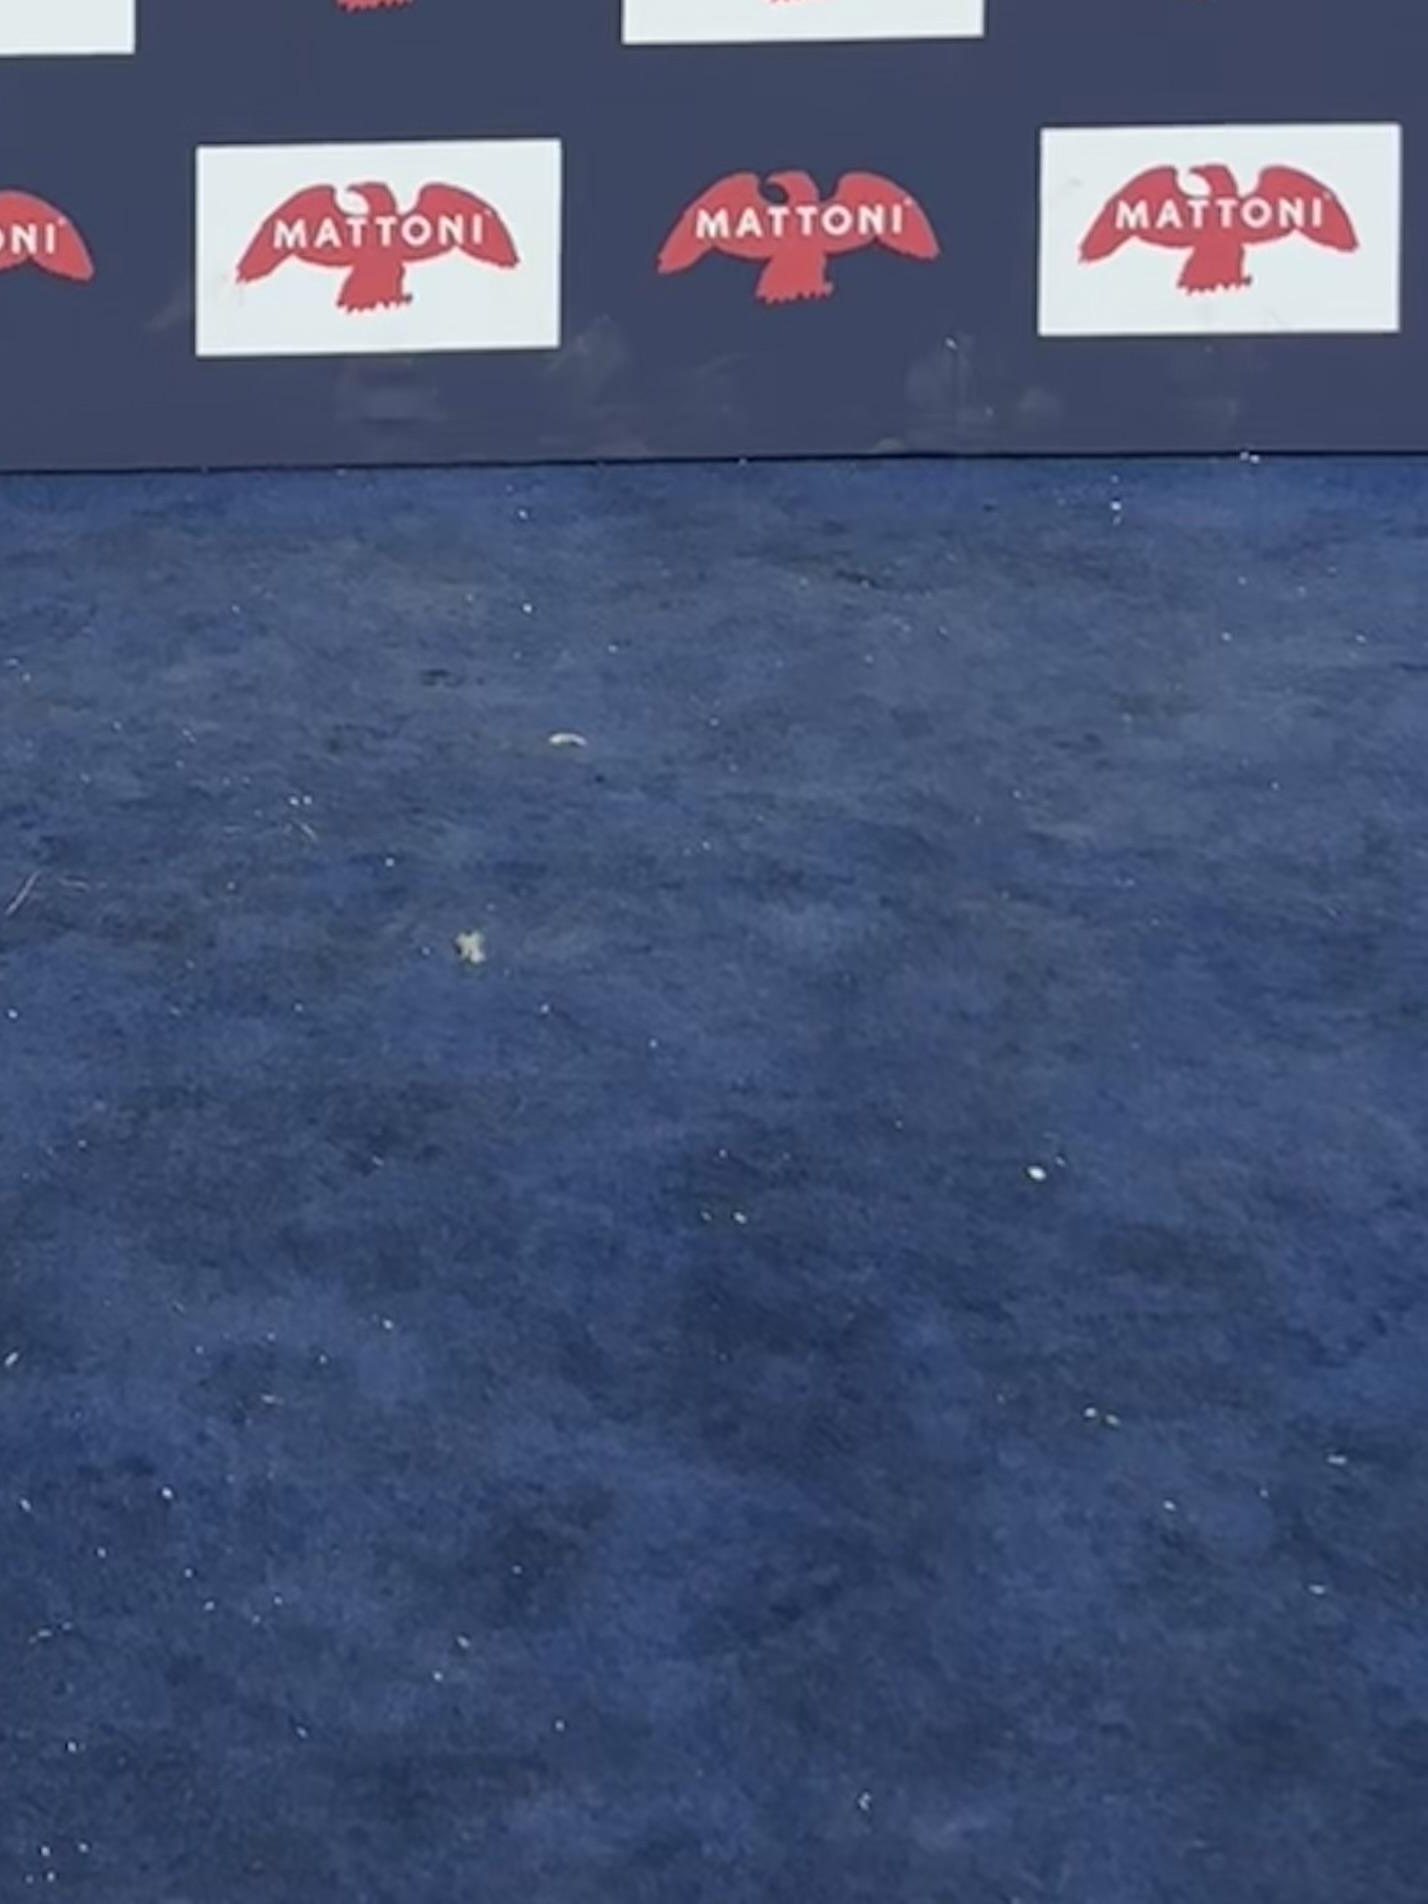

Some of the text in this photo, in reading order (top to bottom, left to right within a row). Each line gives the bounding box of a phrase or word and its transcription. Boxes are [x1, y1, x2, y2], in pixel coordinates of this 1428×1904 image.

[696, 204, 902, 238] MATTONI
[1115, 197, 1322, 229] MATTONI
[273, 214, 482, 249] MATTONI
